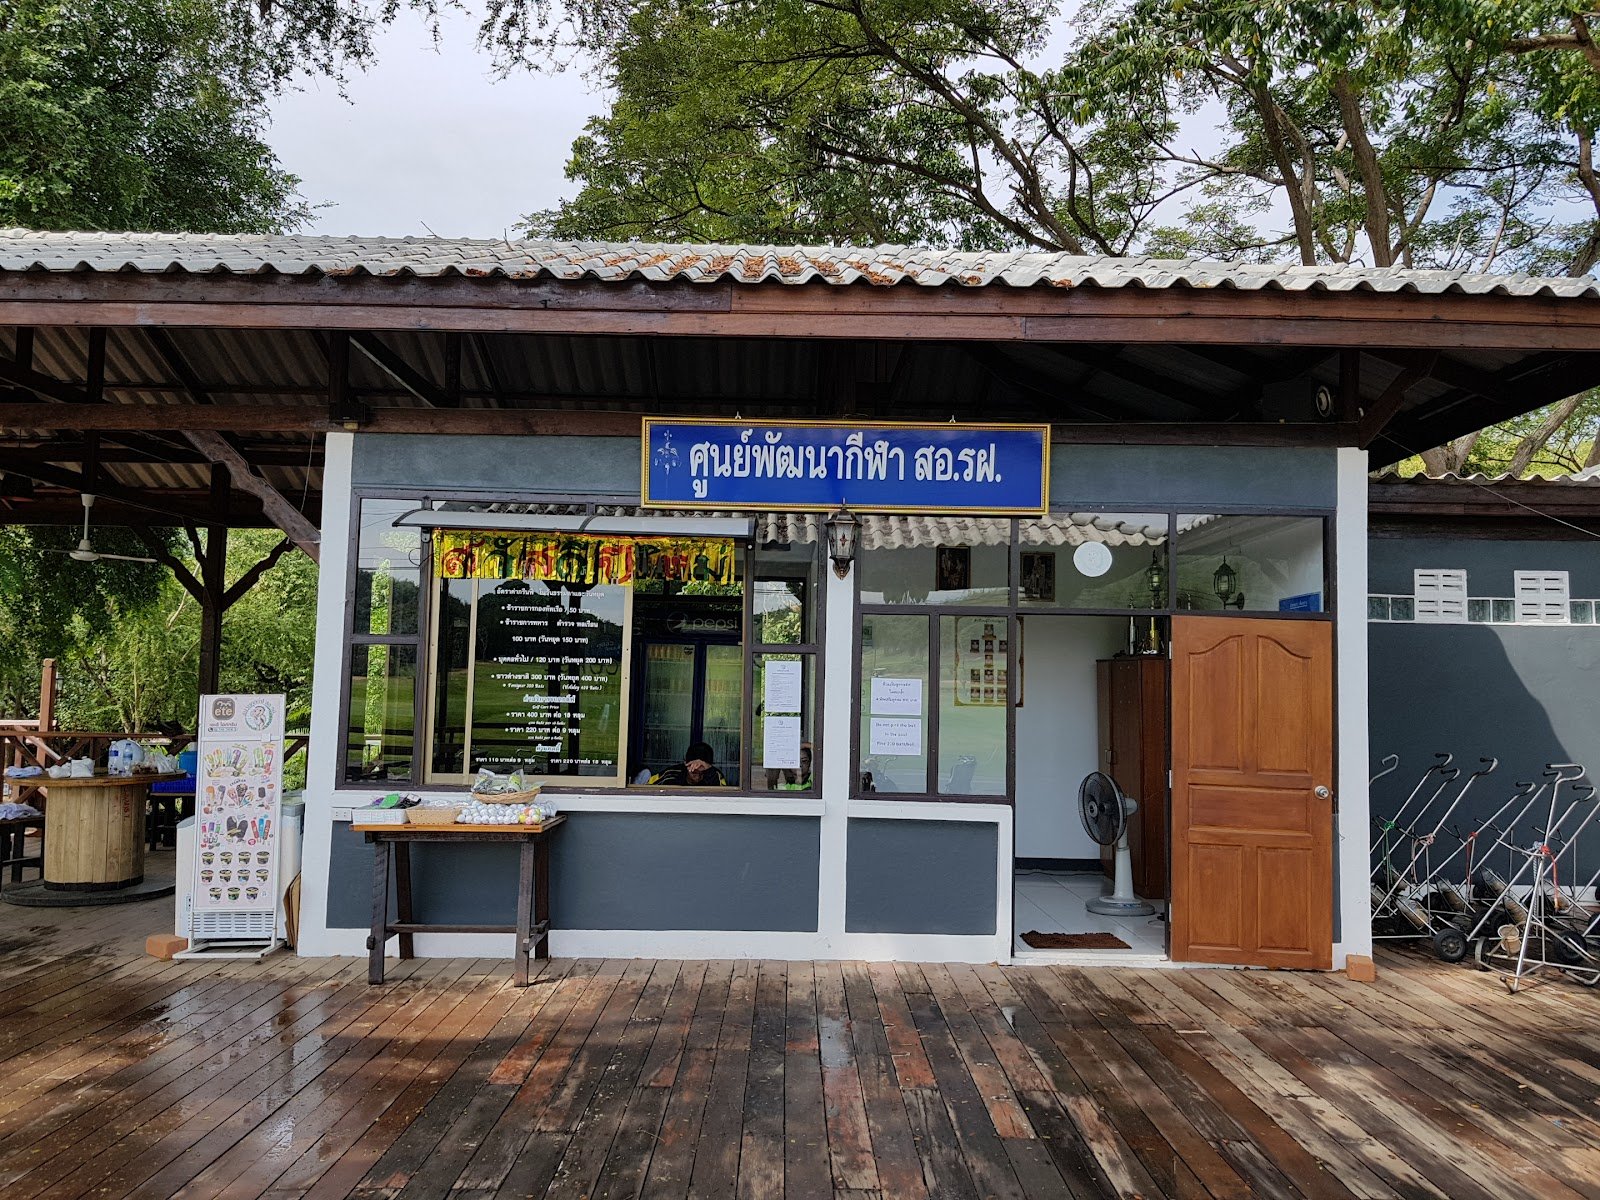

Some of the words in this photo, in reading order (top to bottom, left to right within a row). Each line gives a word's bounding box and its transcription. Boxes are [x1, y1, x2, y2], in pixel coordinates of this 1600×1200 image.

[689, 429, 905, 498] ศูนย์พัฒนากีฬา
[914, 442, 1002, 483] สอ.รฝ.
[692, 617, 737, 631] pepsi
[574, 637, 588, 645] บาท)
[598, 657, 613, 665] บาท)
[594, 675, 608, 683] บาท)
[573, 712, 586, 721] หลุม
[568, 728, 581, 736] หลุม
